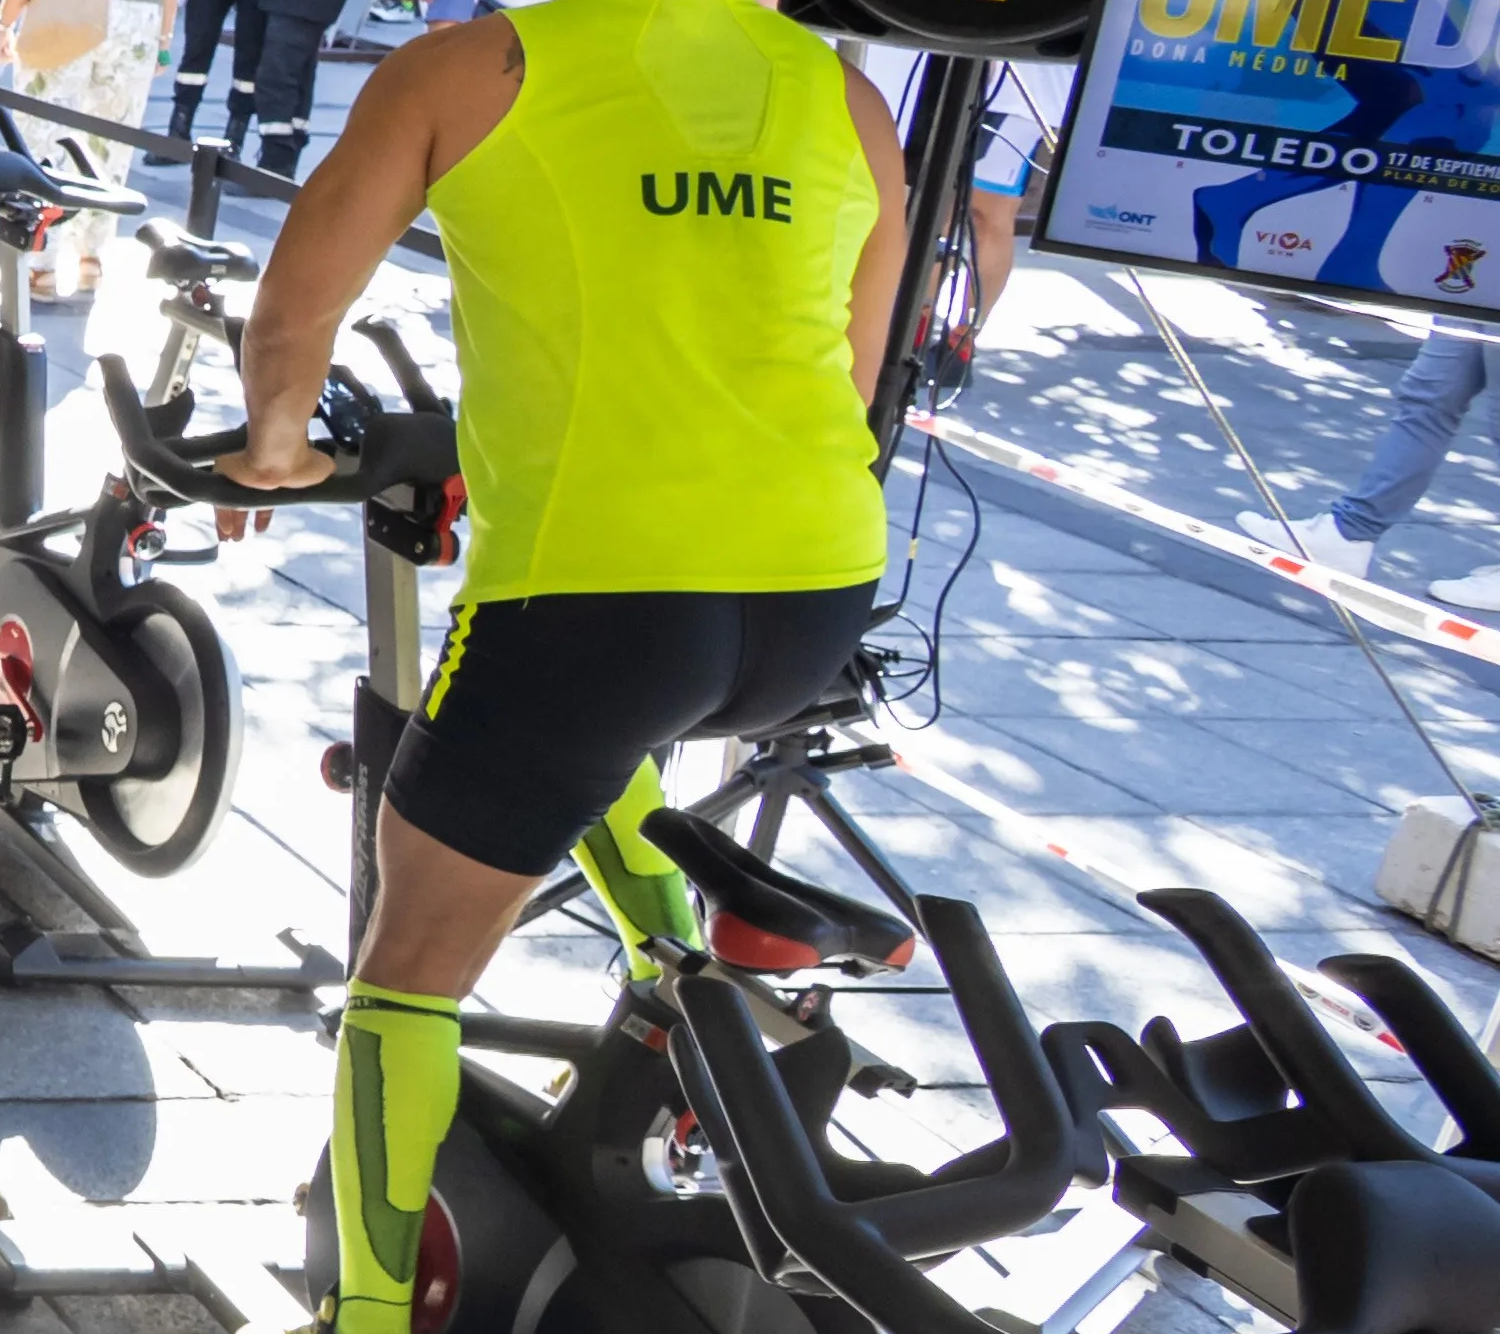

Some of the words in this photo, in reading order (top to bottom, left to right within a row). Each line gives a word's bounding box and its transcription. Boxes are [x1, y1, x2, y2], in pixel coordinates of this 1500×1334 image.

[1130, 38, 1208, 65] DONA
[1227, 47, 1351, 83] MÉDULA
[1171, 122, 1381, 176] TOLEDO
[1387, 151, 1409, 167] 17
[1409, 154, 1433, 171] DE
[639, 172, 794, 225] UME
[1382, 168, 1440, 185] PLAZA
[1447, 178, 1470, 190] DE
